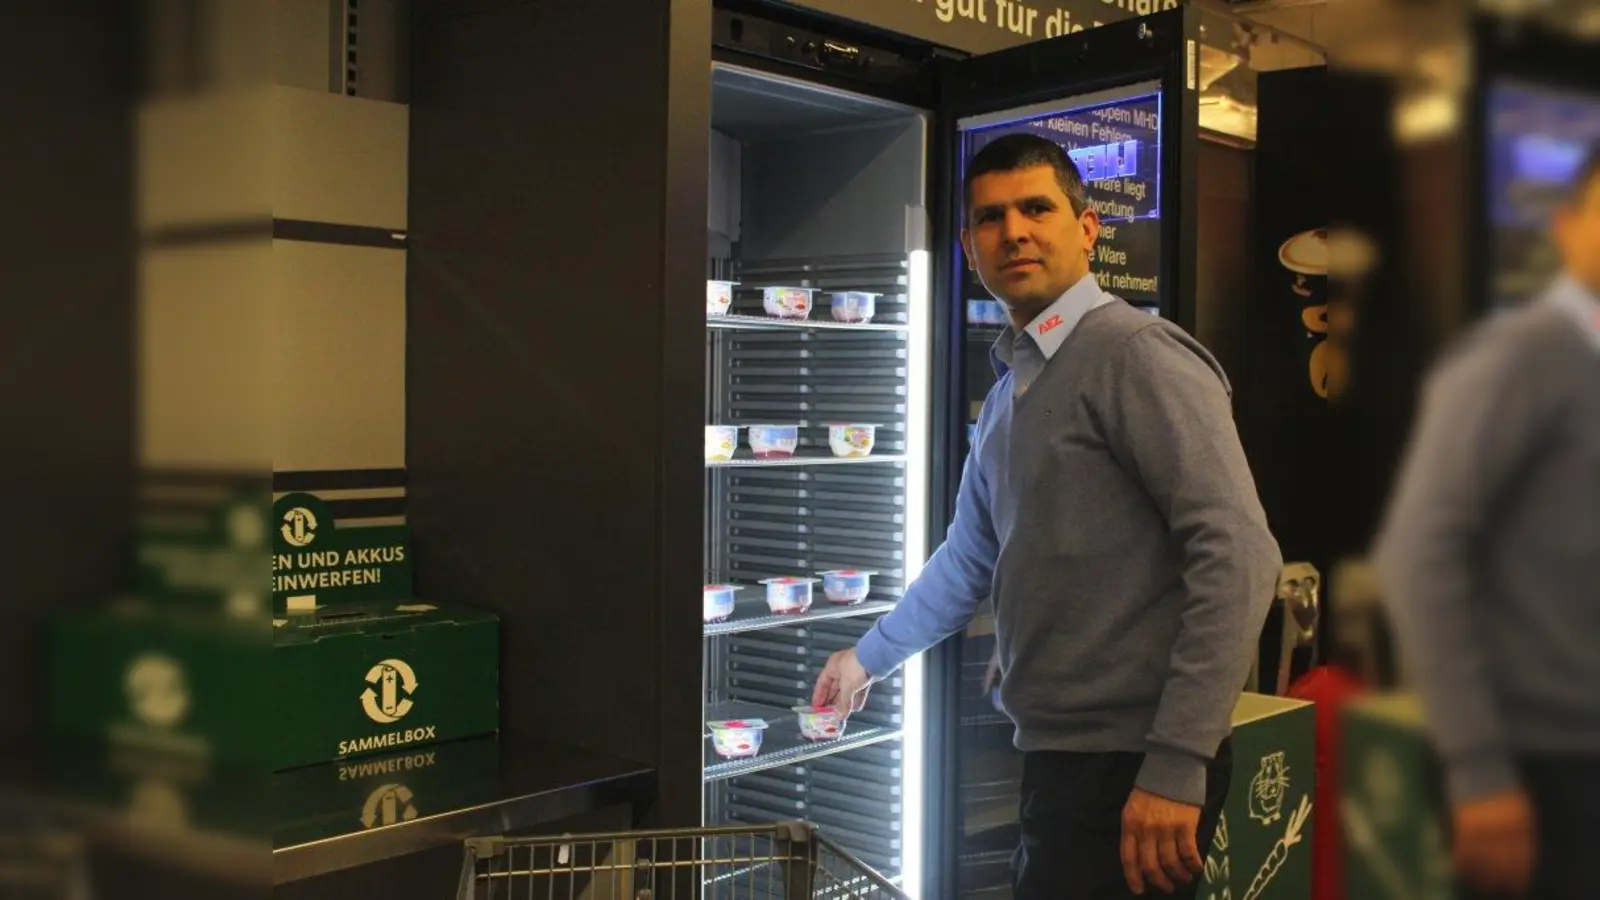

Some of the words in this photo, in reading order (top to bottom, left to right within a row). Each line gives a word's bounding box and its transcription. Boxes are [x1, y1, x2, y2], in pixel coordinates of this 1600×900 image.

[995, 0, 1038, 37] für
[1133, 109, 1158, 131] MHD
[1123, 177, 1146, 201] liegt
[1097, 244, 1126, 266] Ware
[1113, 273, 1158, 292] nehmen!
[298, 551, 340, 568] UND
[344, 546, 405, 565] AKKUS
[338, 726, 436, 756] SAMMELBOX
